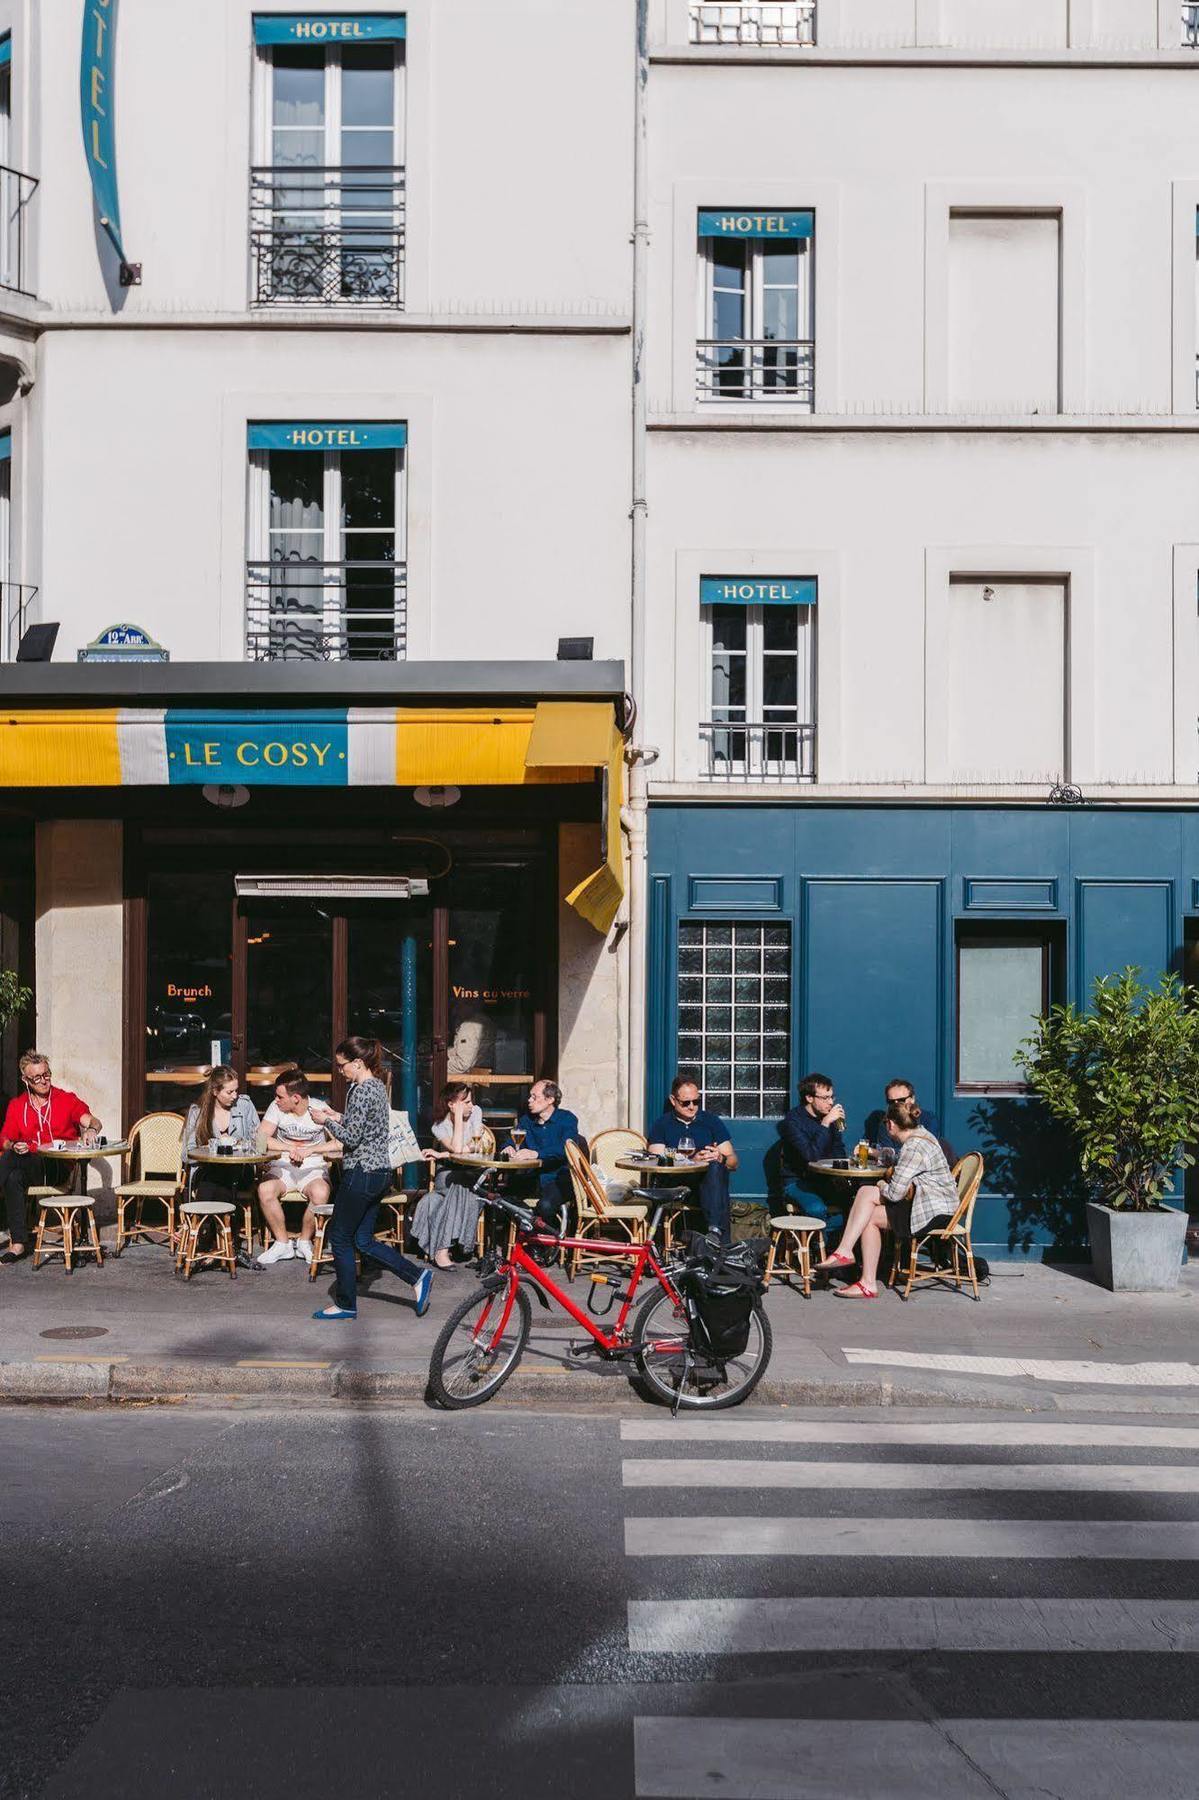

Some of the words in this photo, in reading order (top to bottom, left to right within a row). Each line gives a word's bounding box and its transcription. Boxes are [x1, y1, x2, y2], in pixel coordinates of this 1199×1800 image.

[296, 22, 364, 38] HOTEL
[92, 0, 107, 168] TEL
[721, 216, 789, 232] HOTEL
[292, 429, 360, 445] HOTEL
[724, 585, 792, 600] HOTEL
[184, 743, 222, 766] LE
[236, 742, 332, 766] COSY
[167, 984, 212, 997] Brunch
[452, 986, 480, 998] Vins
